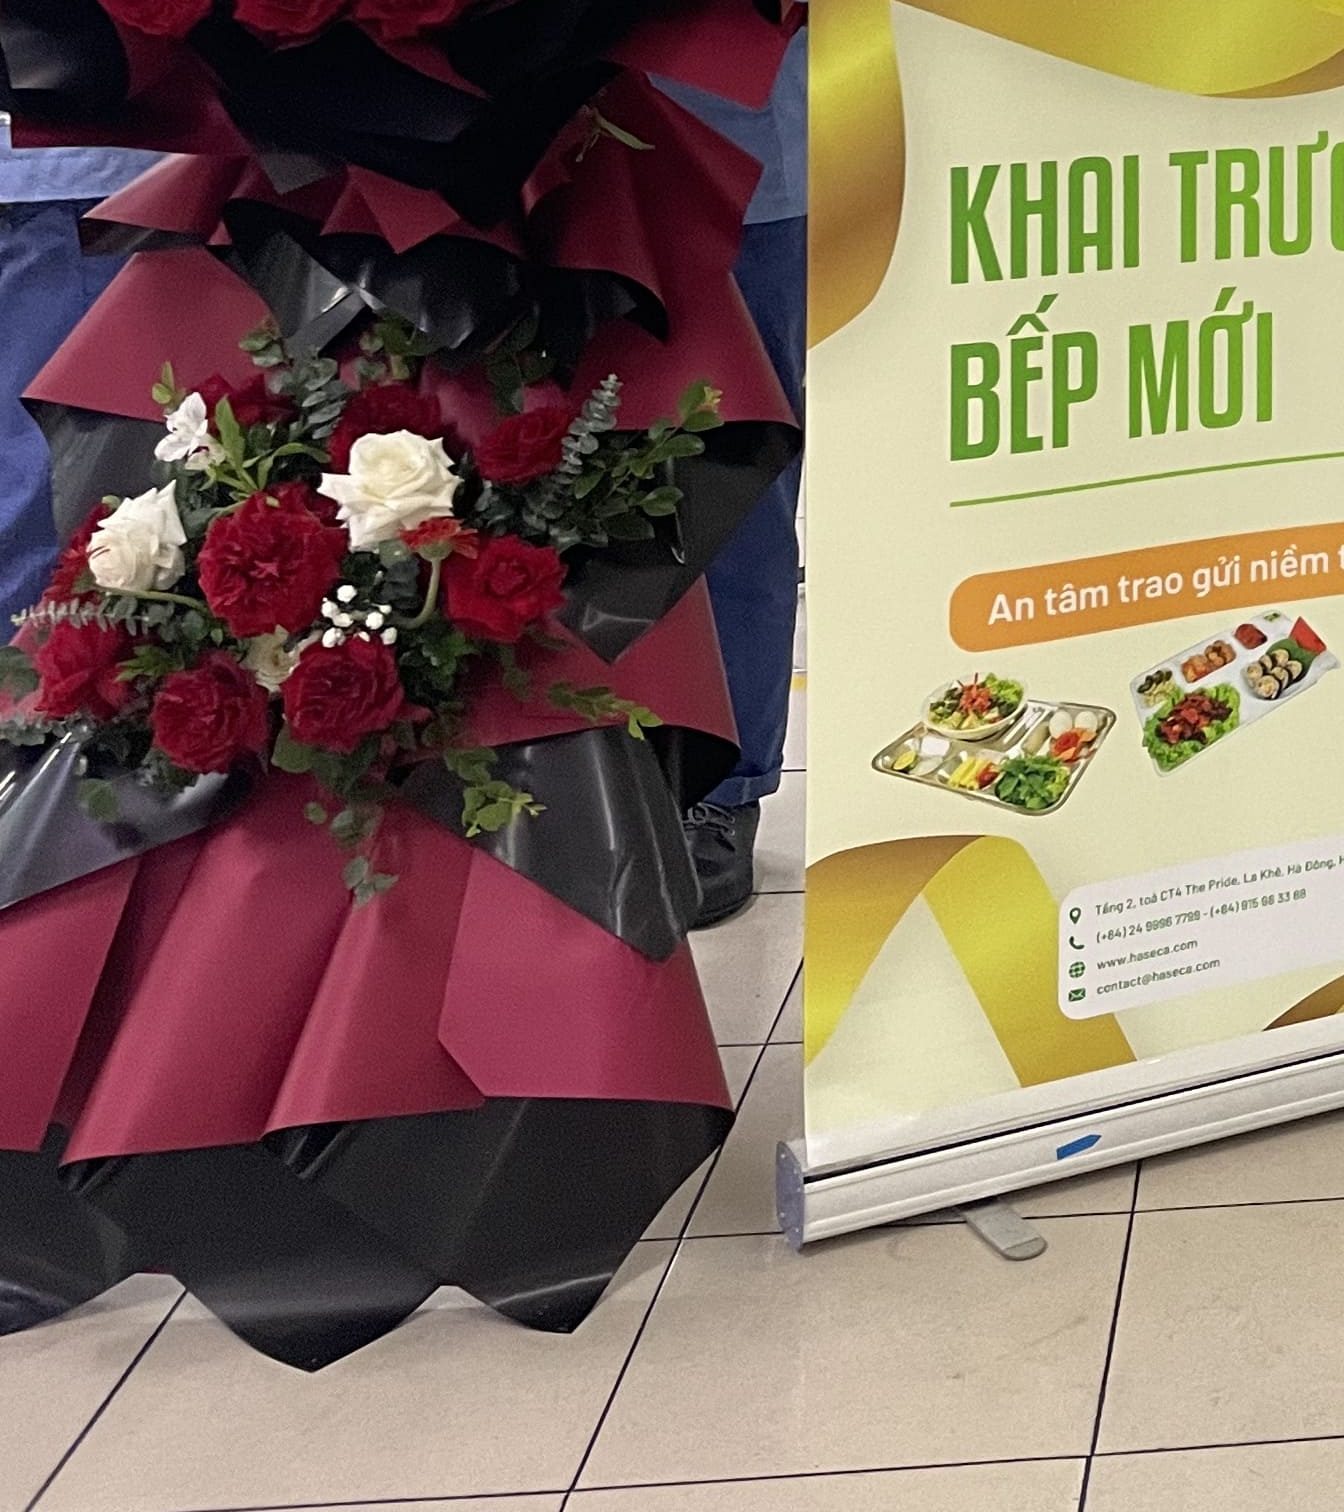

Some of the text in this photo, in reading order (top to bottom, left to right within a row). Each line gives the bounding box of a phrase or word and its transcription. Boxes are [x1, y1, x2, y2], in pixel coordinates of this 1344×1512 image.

[949, 153, 1141, 285] KHAI
[949, 286, 1274, 462] BẾP MỚI
[987, 592, 1035, 626] An
[1044, 583, 1109, 616] tâm
[1118, 572, 1183, 604] trao
[1192, 555, 1241, 599] gửi
[1249, 543, 1329, 584] niềm
[1160, 887, 1183, 902] CT4
[1185, 883, 1206, 896] The
[1096, 926, 1127, 943] (+84)
[1128, 923, 1143, 937] 24
[1096, 938, 1199, 970] www.haseca.com
[1096, 958, 1221, 995] contact@haseca.com
